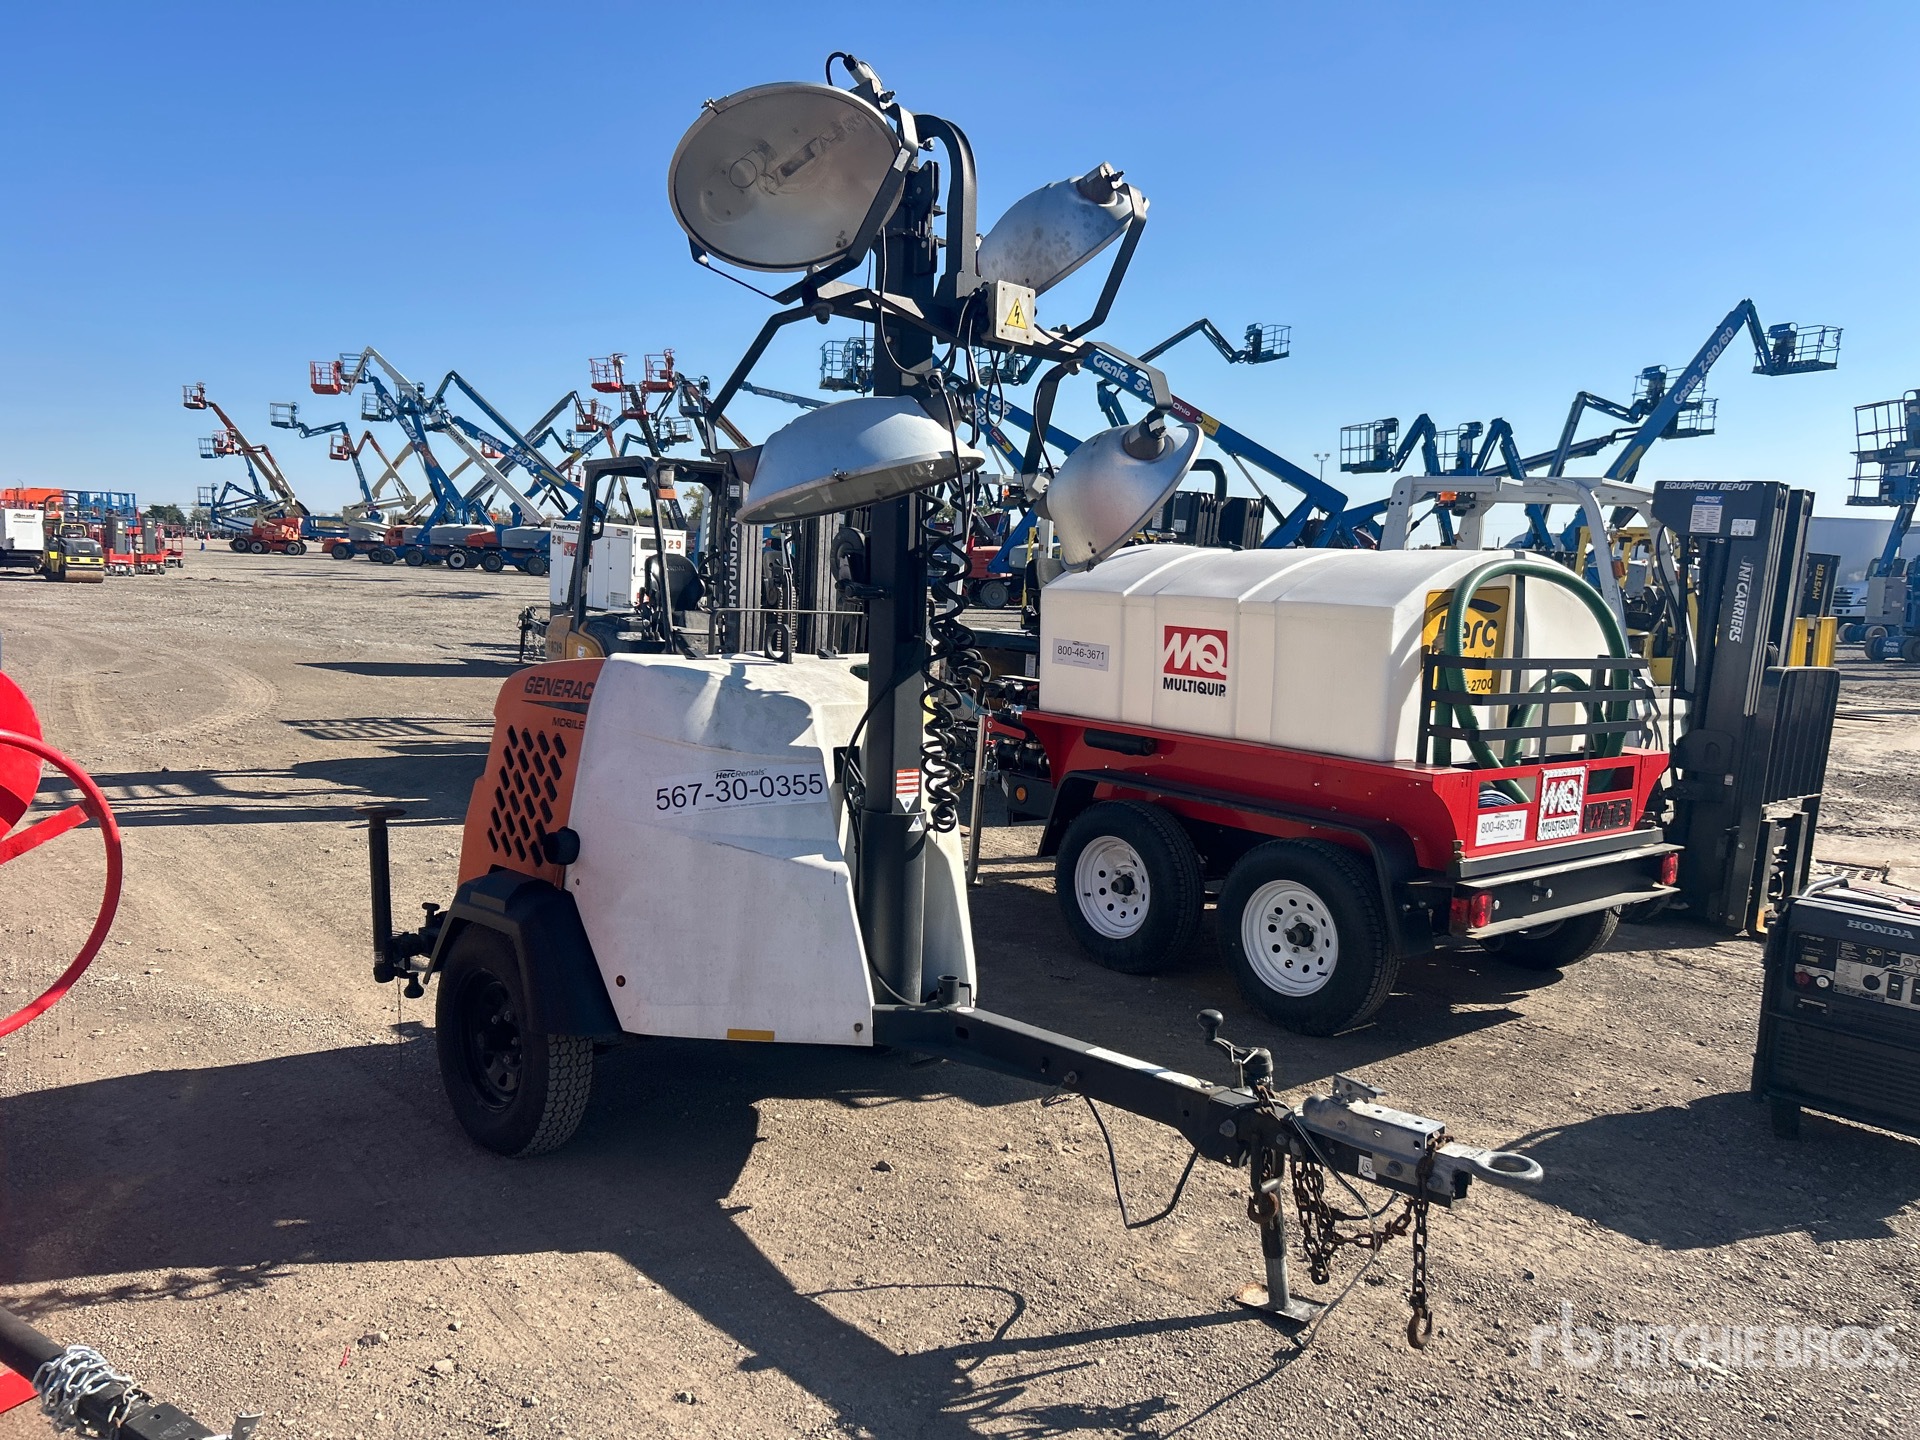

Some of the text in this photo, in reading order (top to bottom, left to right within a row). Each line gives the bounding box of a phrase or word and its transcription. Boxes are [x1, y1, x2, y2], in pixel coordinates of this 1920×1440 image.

[1093, 354, 1129, 383] Genie
[1673, 326, 1734, 405] Genie Z-80/60
[382, 392, 399, 415] Genie
[1172, 402, 1191, 417] Ohio
[446, 424, 465, 446] norkel
[477, 431, 503, 450] Genie
[1663, 481, 1753, 491] EQUIPMENT DEPOT
[552, 522, 576, 531] PowerPro
[668, 540, 682, 549] 29
[1811, 563, 1825, 600] HYSTER
[1057, 645, 1105, 661] 800-46-3671
[1163, 631, 1228, 676] MQ
[524, 675, 596, 700] GENERAC
[1162, 676, 1227, 697] MULTIQUIP
[1467, 677, 1494, 692] -2700
[551, 716, 585, 730] MOBILE
[656, 773, 824, 811] 567-30-0355
[1480, 818, 1523, 834] 800-46-3671
[1846, 919, 1915, 940] HONDA
